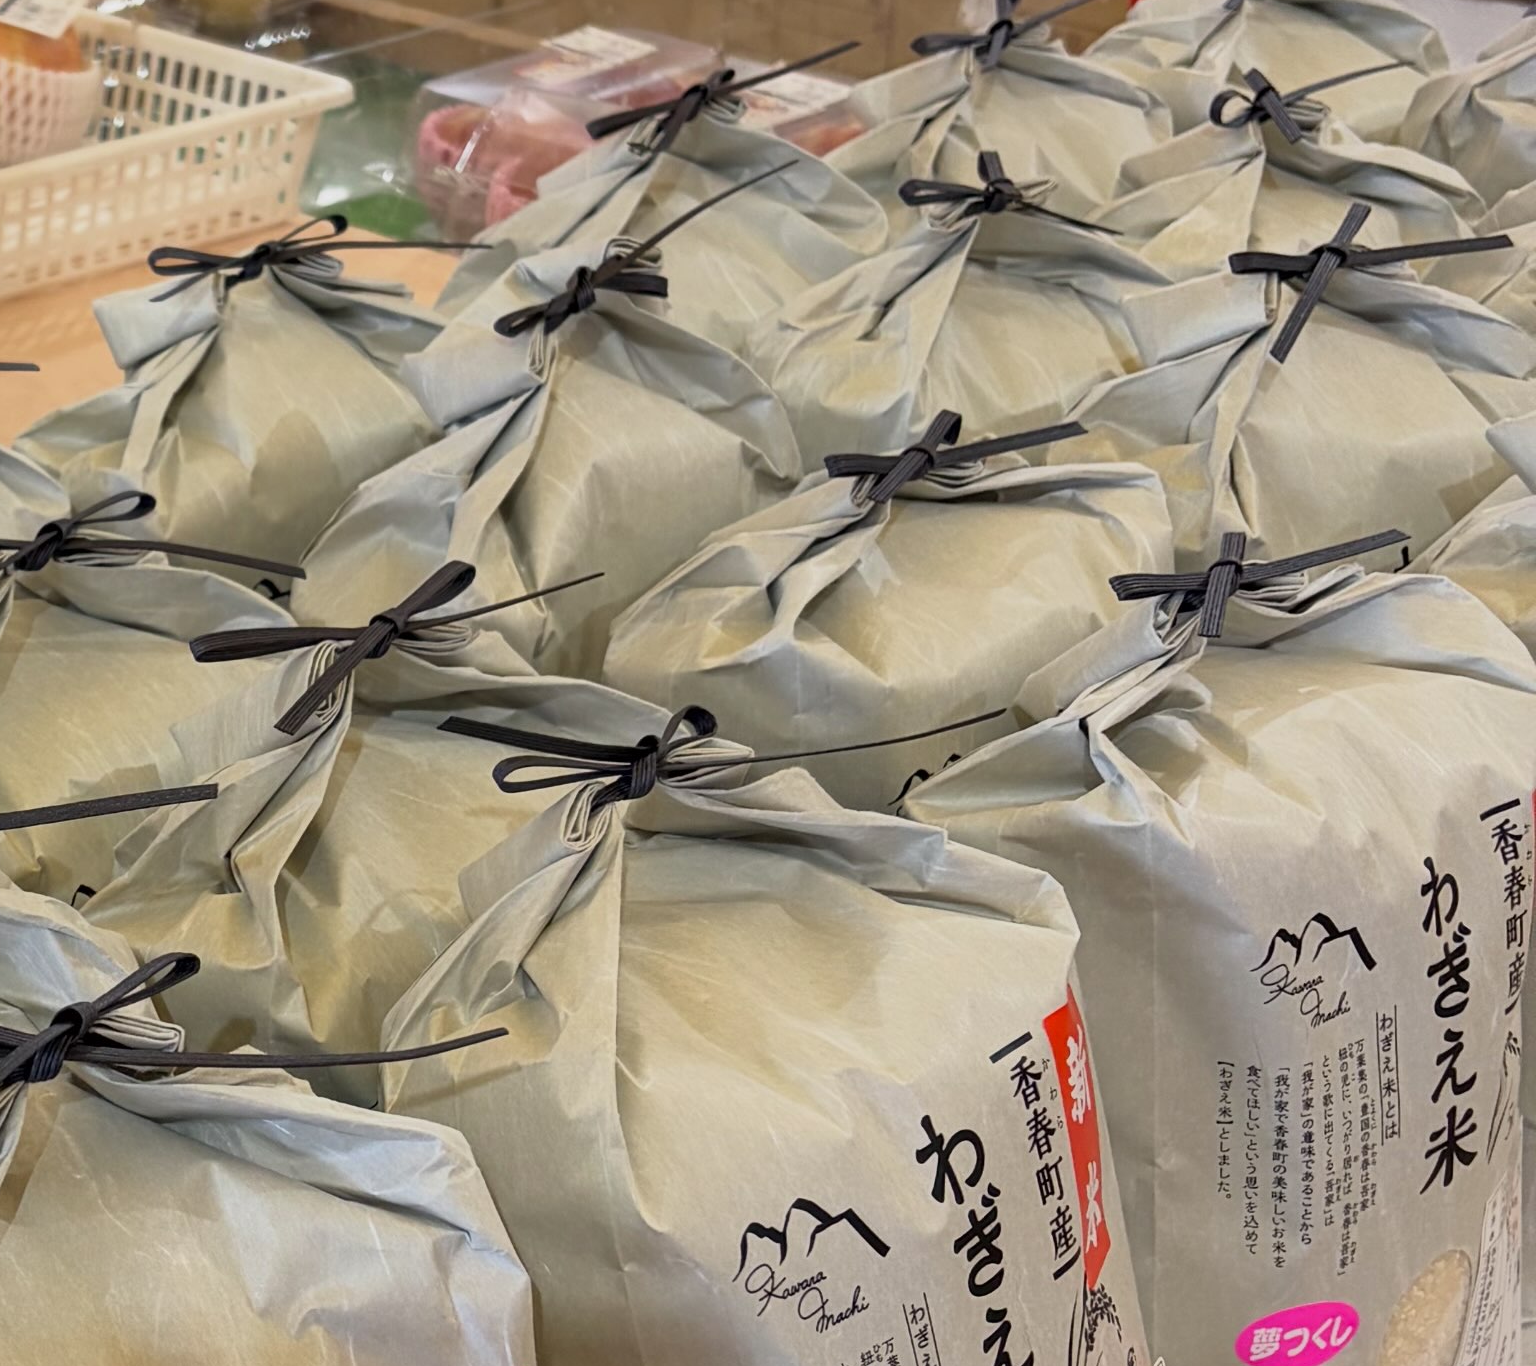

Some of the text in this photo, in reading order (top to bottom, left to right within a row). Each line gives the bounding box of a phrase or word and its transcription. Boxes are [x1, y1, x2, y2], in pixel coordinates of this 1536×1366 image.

[1491, 822, 1528, 998] 香春町産
[1420, 857, 1477, 1194] わぎえ米
[1011, 1055, 1078, 1260] 香春町産
[1068, 1028, 1103, 1251] 新米
[1249, 1315, 1353, 1362] 夢つくし
